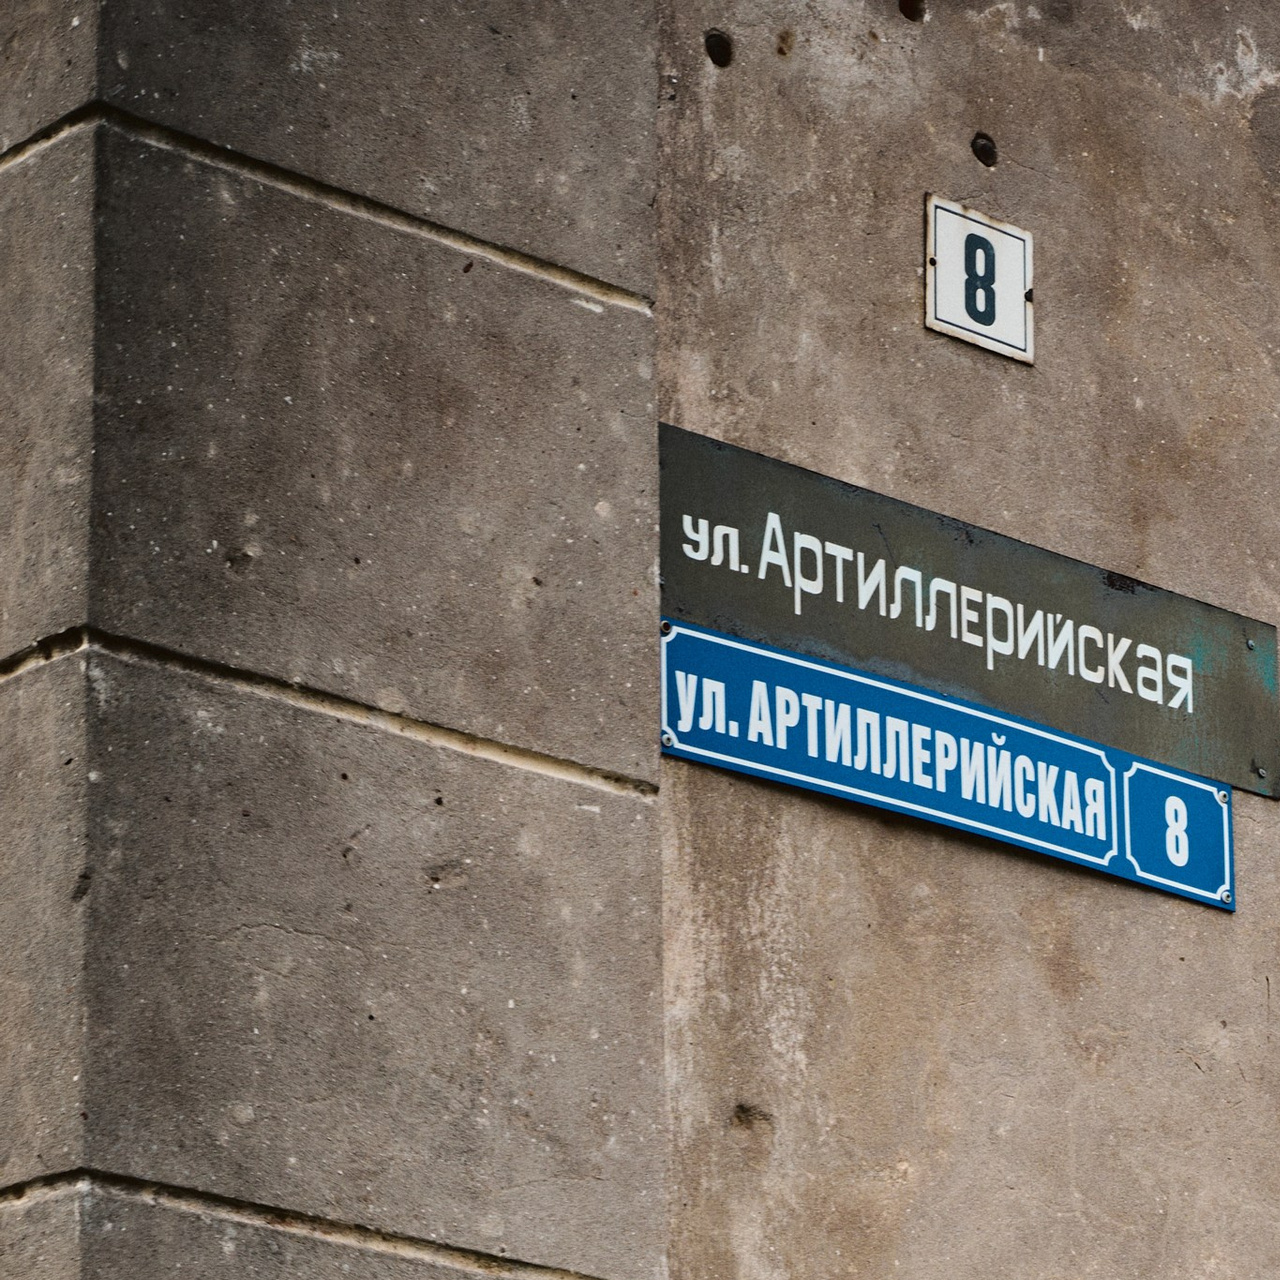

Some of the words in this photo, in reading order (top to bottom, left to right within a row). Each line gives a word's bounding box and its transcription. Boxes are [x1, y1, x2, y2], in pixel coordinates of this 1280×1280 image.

[963, 232, 996, 327] 8
[682, 514, 749, 574] ул.
[757, 511, 1194, 713] Артиллерийская
[747, 679, 1107, 841] АРТИЛЛЕРИЙСКАЯ
[1164, 795, 1189, 867] 8
